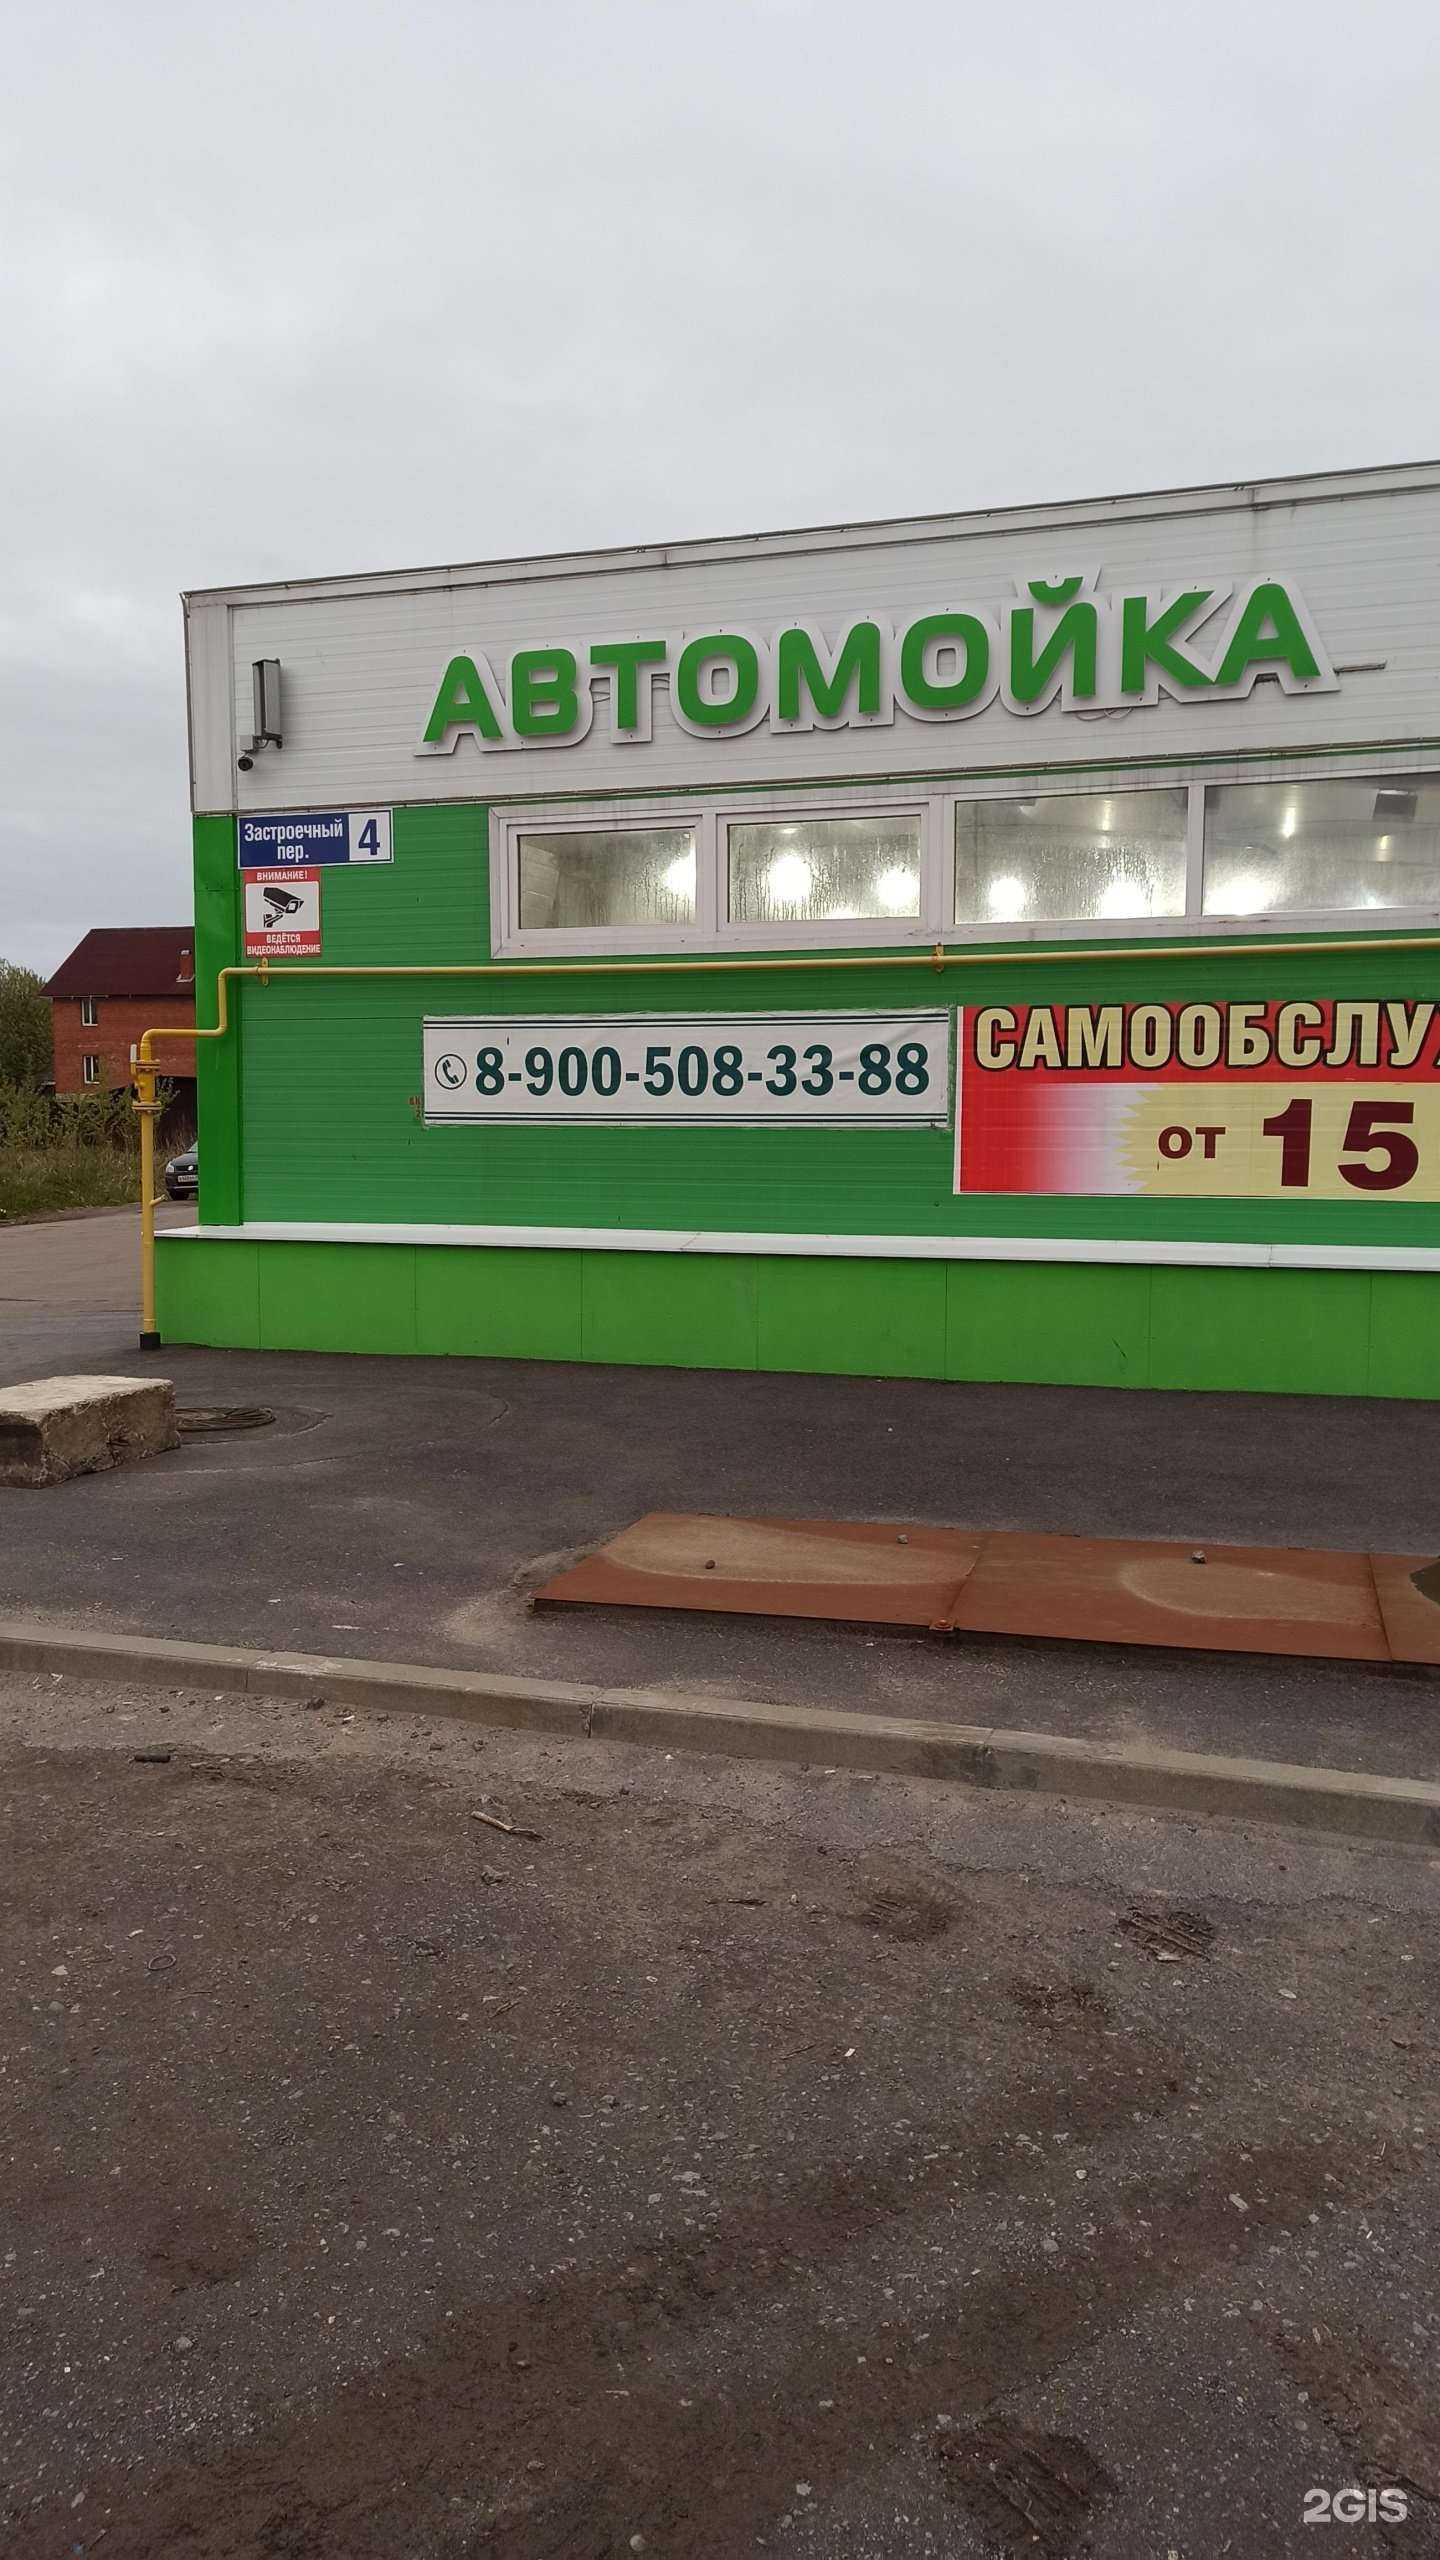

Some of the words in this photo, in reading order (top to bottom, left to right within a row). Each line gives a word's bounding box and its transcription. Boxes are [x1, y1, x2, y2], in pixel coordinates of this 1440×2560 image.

[422, 575, 1322, 744] АВТОМОЙКА
[243, 817, 344, 844] Застроечный
[358, 819, 380, 855] 4
[277, 844, 310, 863] пер.
[256, 870, 308, 881] ВНИМАНИЕ!
[247, 944, 320, 956] ВИДЕОНАБЛЮДЕНИЕ
[266, 933, 301, 944] ВЕДЁТСЯ
[974, 999, 1440, 1070] САМООБСЛУ
[475, 1042, 930, 1097] 8-900-508-33-88
[1262, 1098, 1420, 1191] 15
